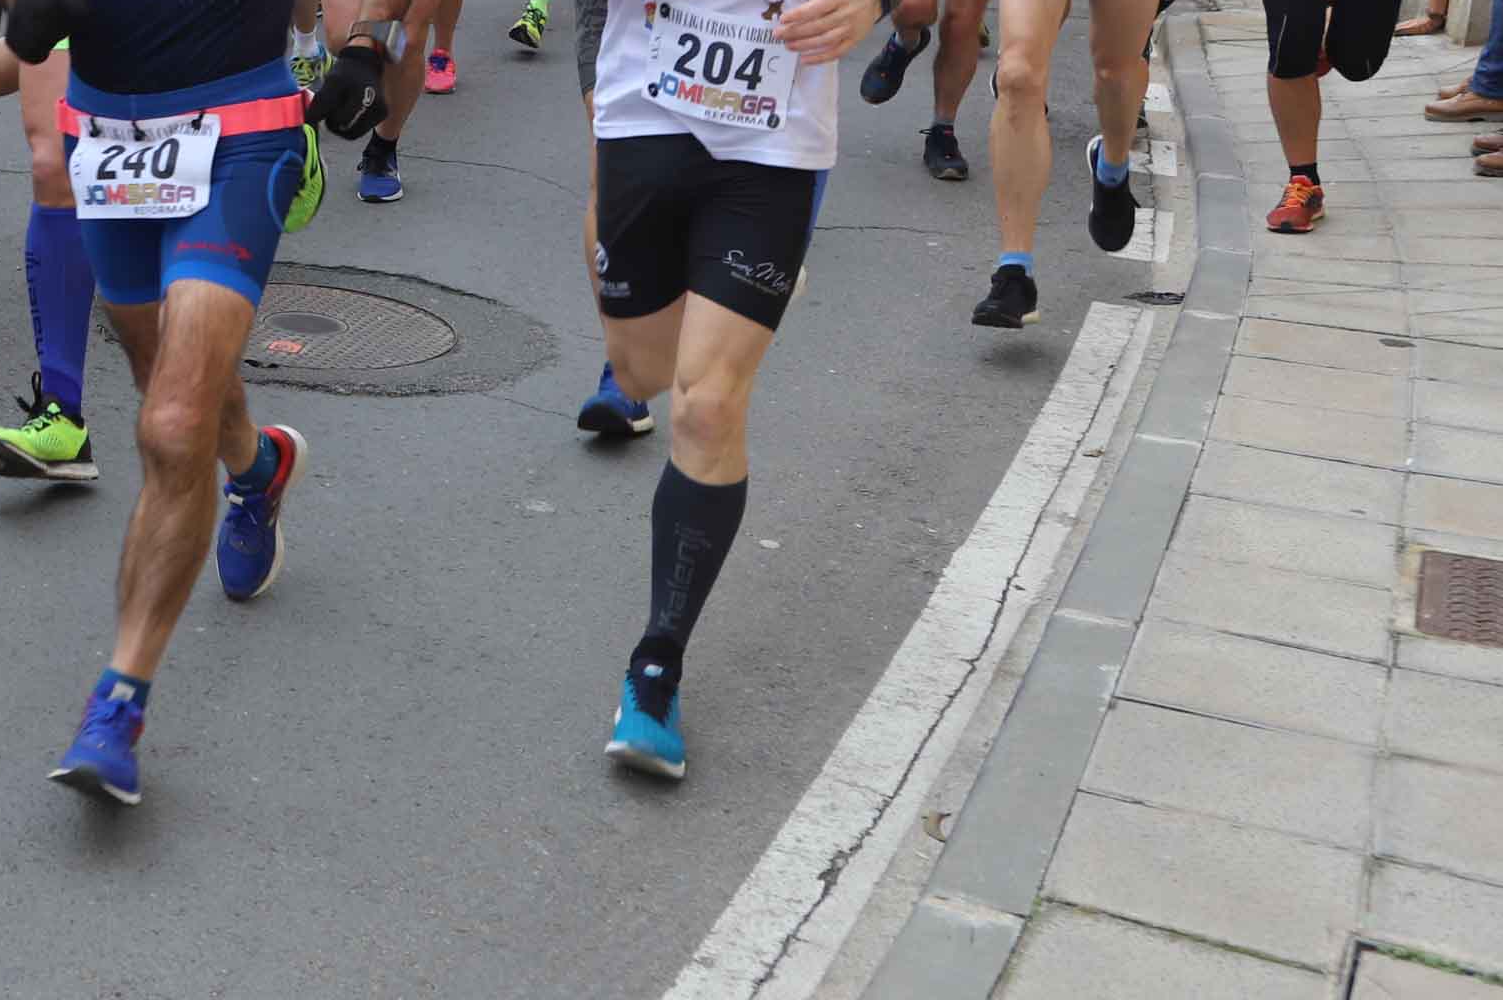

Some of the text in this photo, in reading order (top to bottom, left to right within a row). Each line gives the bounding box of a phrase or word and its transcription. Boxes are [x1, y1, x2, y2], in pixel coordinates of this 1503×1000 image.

[672, 31, 766, 91] 204
[704, 109, 767, 127] REFORMA
[96, 137, 181, 182] 240
